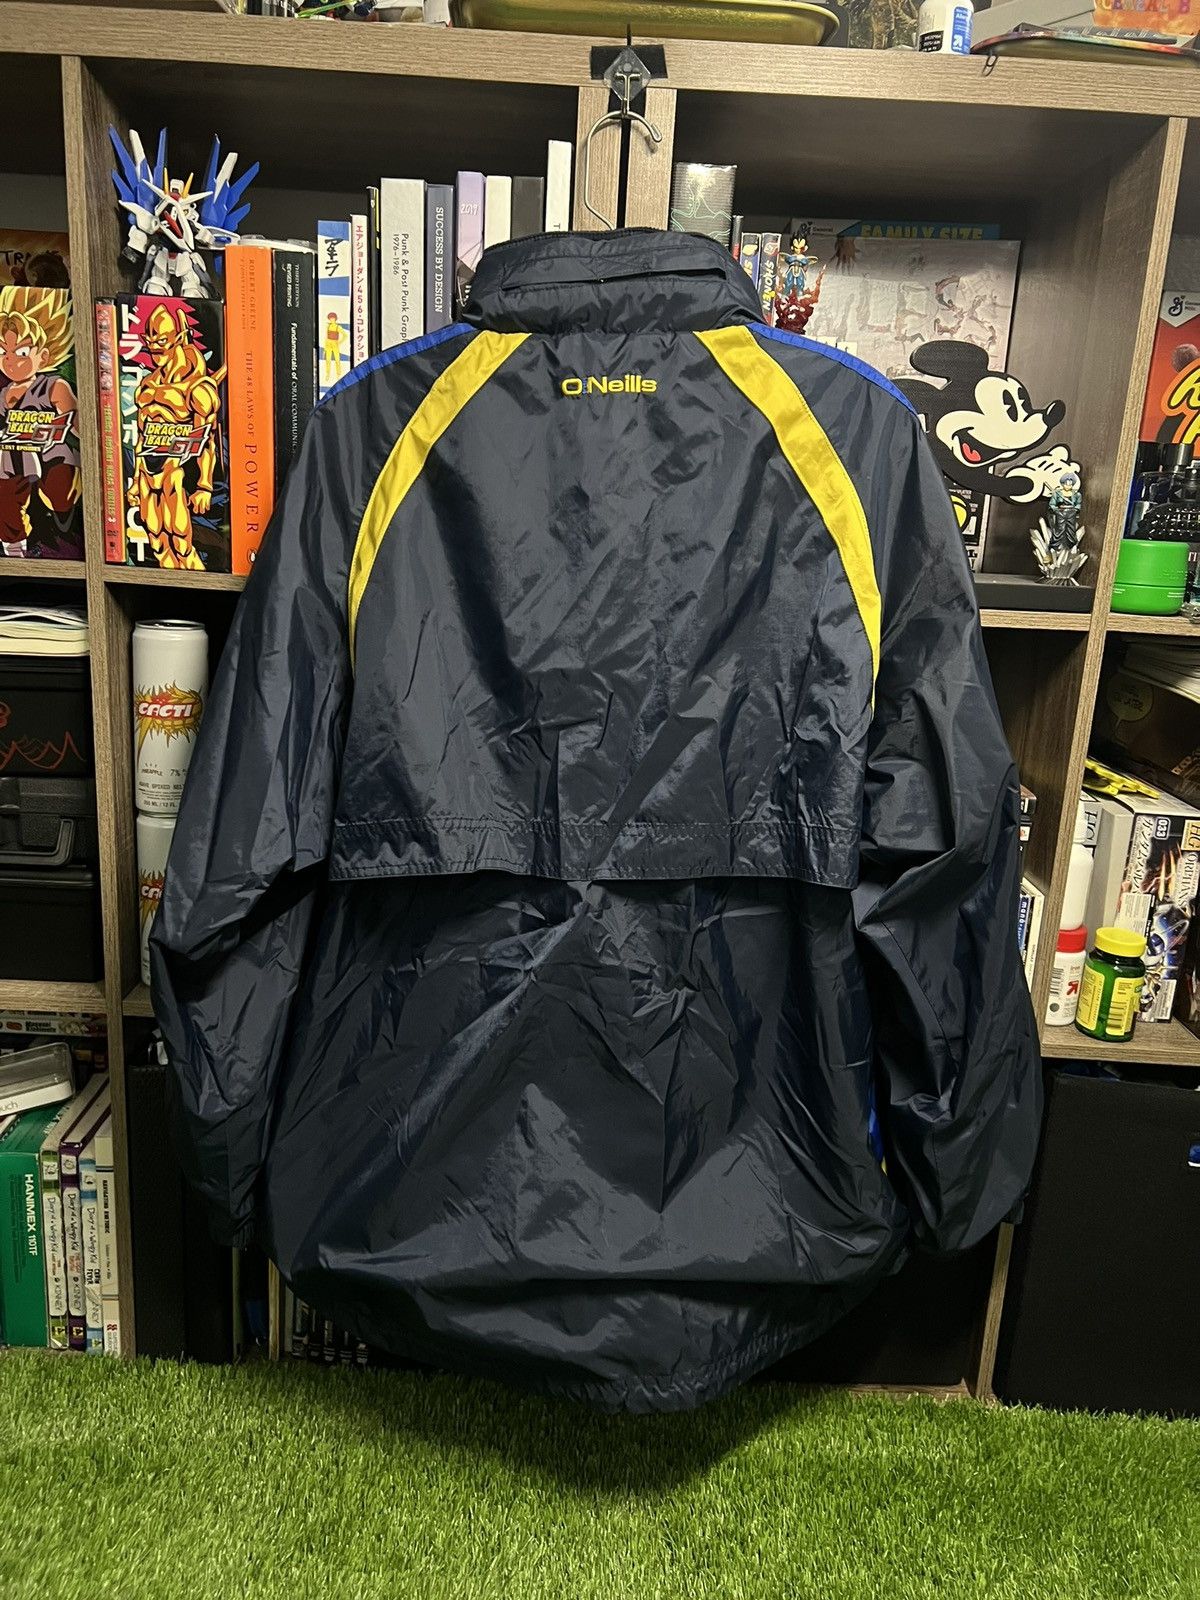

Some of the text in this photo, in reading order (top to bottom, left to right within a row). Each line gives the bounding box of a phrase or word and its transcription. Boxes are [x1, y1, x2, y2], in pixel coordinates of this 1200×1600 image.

[860, 224, 984, 240] FAMILY SIZE
[401, 233, 410, 256] Punk
[324, 237, 343, 277] アキラ
[434, 206, 444, 313] SUCCESS BY DESIGN
[401, 268, 409, 285] Post
[761, 259, 776, 311] SHONEN
[401, 289, 410, 312] Punk
[246, 376, 253, 387] 48
[291, 372, 298, 380] of
[290, 382, 298, 401] ORAL
[9, 411, 53, 433] DRAGON BALL
[247, 423, 255, 437] OF
[32, 424, 67, 450] GT
[147, 424, 192, 446] DRAGON BALL
[168, 437, 205, 461] GT
[245, 443, 259, 533] POWER
[138, 702, 193, 718] CACTI
[1156, 819, 1168, 839] 033
[24, 1173, 37, 1232] HANIMEX
[67, 1193, 77, 1210] Diary
[72, 1241, 80, 1251] Kid
[86, 1268, 94, 1285] FEVER
[54, 1284, 63, 1311] KINNEY
[73, 1283, 82, 1311] KINNEY
